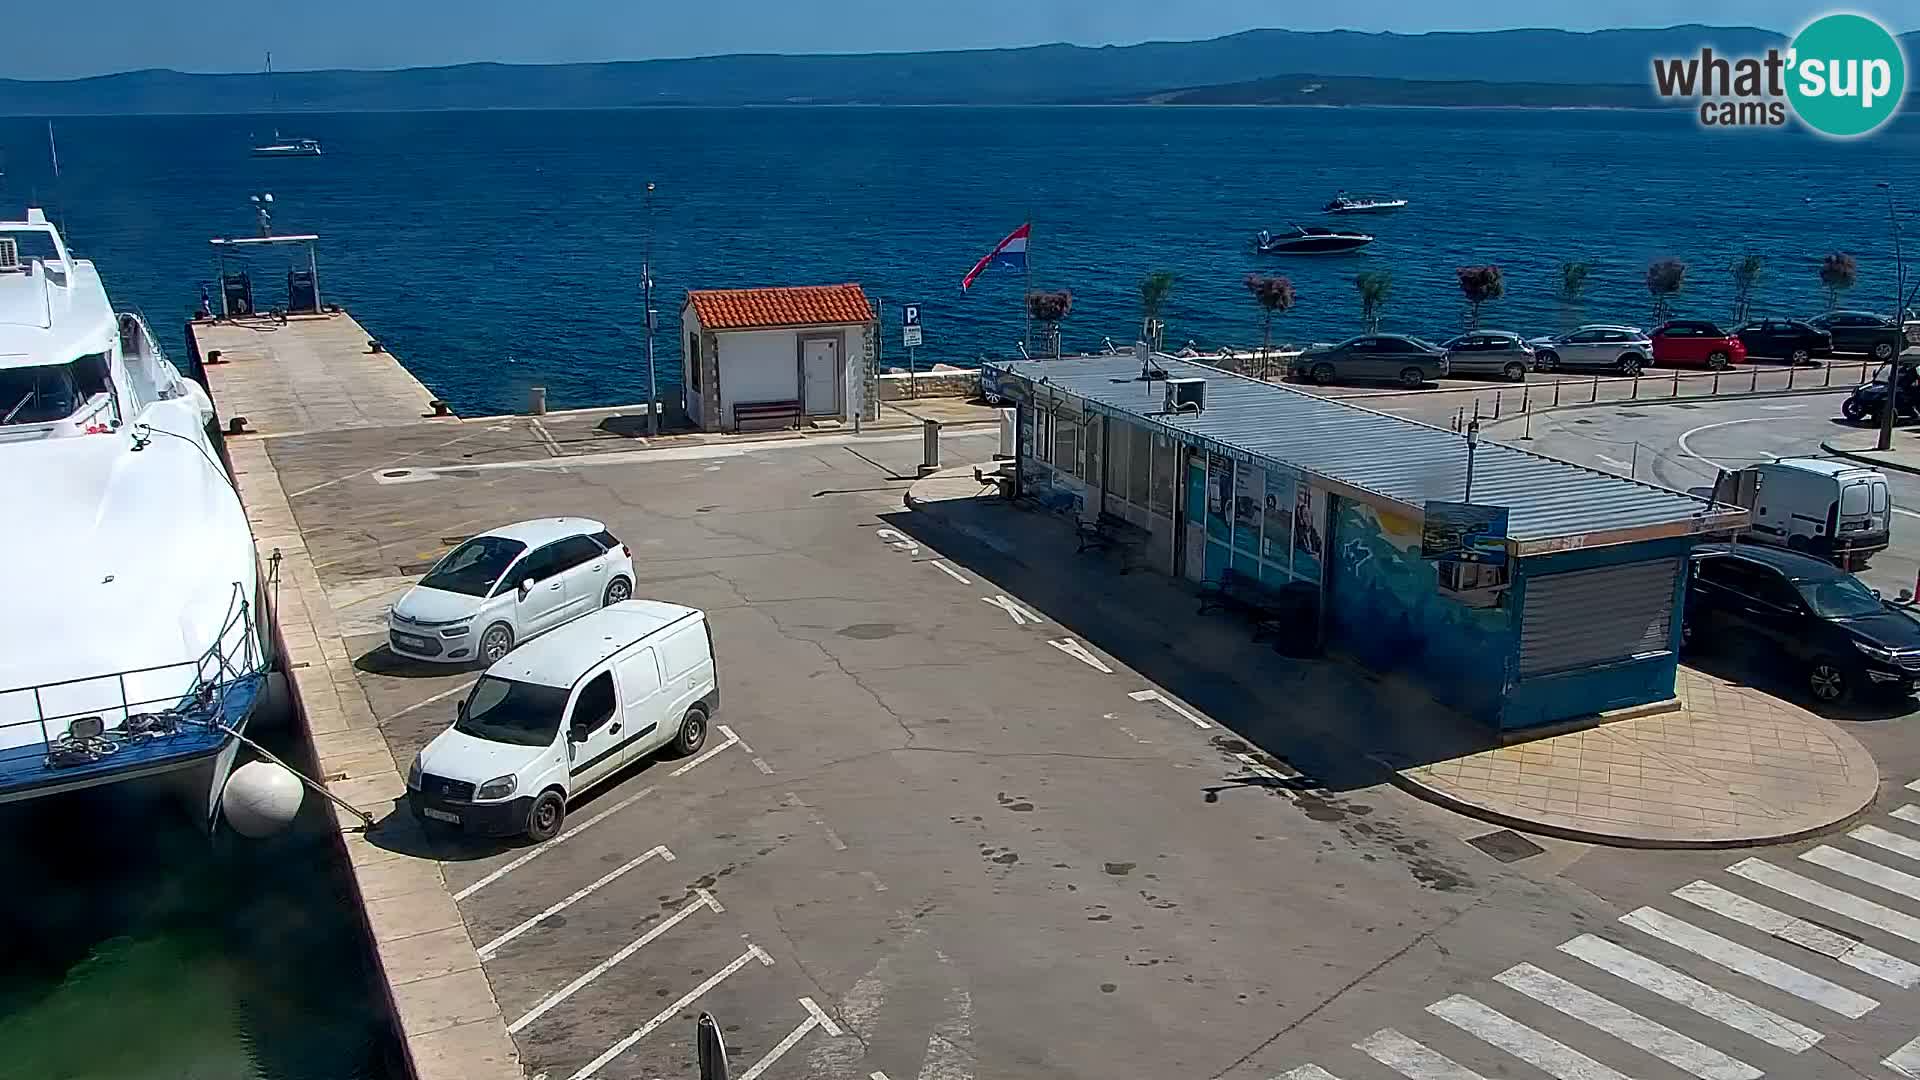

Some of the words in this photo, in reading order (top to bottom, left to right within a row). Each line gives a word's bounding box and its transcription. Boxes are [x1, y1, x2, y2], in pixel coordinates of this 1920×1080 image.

[907, 307, 917, 324] P
[1204, 440, 1218, 453] BUS
[1219, 445, 1249, 464] STATION
